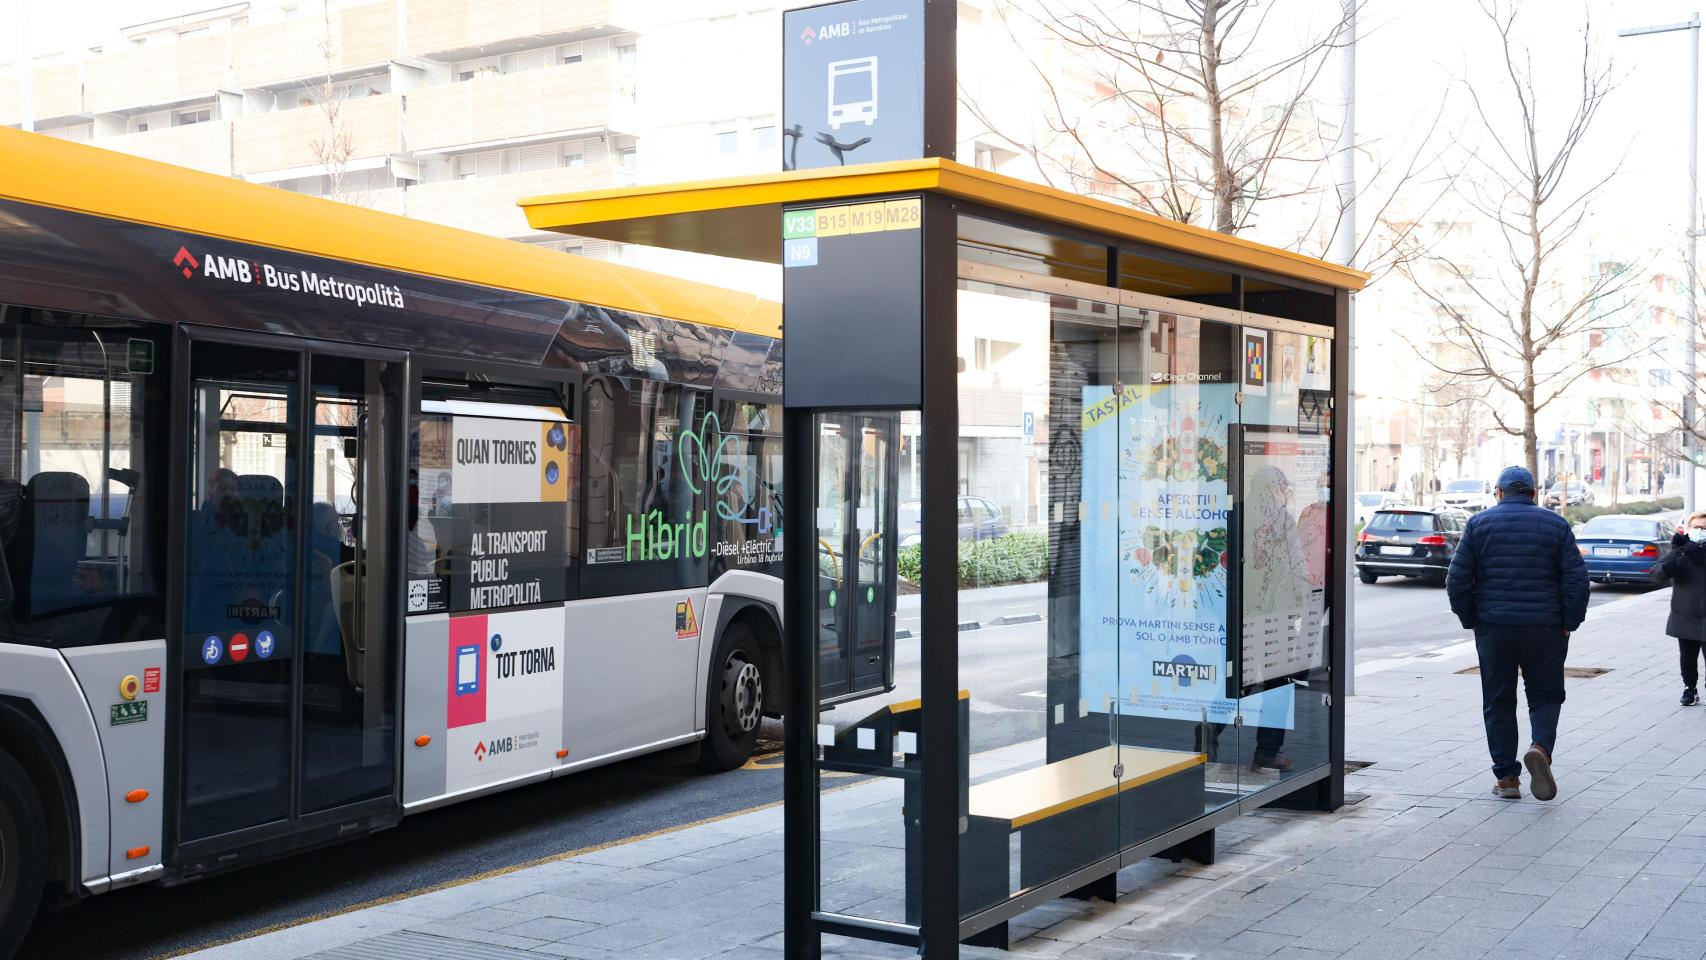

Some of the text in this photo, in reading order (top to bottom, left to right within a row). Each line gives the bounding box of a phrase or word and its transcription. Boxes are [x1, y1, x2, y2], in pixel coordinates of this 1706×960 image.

[818, 22, 850, 41] AMB
[785, 206, 919, 234] V33 B15 M19 M28
[790, 244, 811, 261] N9
[204, 254, 405, 308] AMB Bus Metropolità
[1187, 371, 1222, 381] Channel
[456, 438, 537, 466] QUAN TORNES
[470, 530, 547, 556] AL TRANSPORT
[626, 508, 708, 562] Híbrid
[470, 556, 509, 583] PÚBLIC
[765, 553, 784, 565] hybrid
[470, 578, 541, 610] METROPOLITÀ
[1102, 616, 1136, 627] PROVA
[1138, 619, 1180, 630] MARTINI
[1183, 621, 1215, 632] SENSE
[1136, 631, 1156, 641] SOL
[1158, 633, 1166, 642] O
[1168, 635, 1191, 644] AMB
[495, 646, 555, 679] TOT TORNA
[488, 737, 513, 756] AMB
